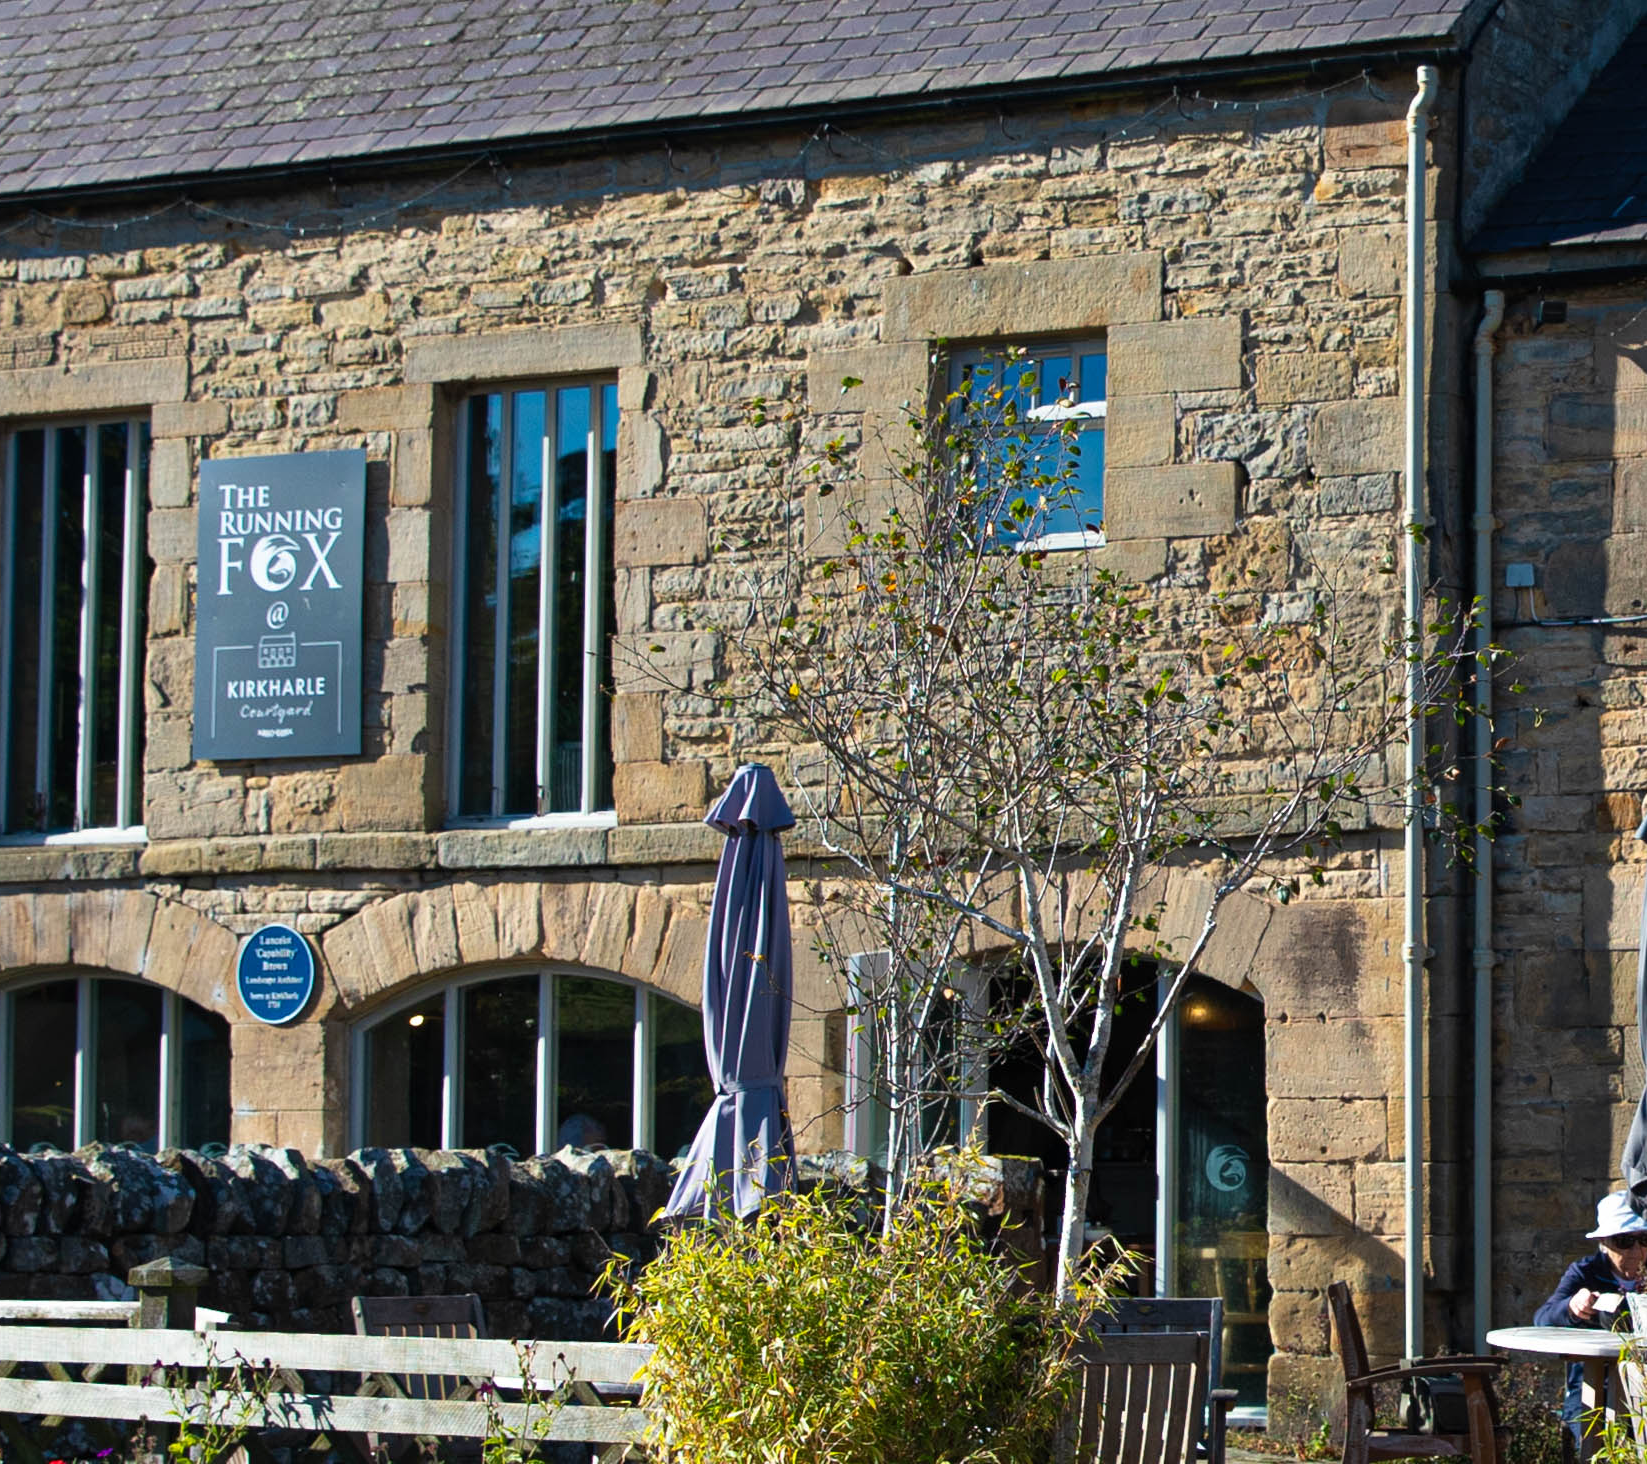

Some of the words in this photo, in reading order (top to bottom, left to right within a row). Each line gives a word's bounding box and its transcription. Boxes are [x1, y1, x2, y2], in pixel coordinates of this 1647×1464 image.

[218, 484, 270, 508] THE
[218, 508, 343, 536] RUNNING
[217, 532, 342, 596] FOX
[266, 601, 289, 630] @
[227, 676, 326, 699] KIRKHARLE
[239, 700, 314, 724] Courtyard
[259, 935, 292, 945] Lancelot
[262, 961, 288, 971] Brown
